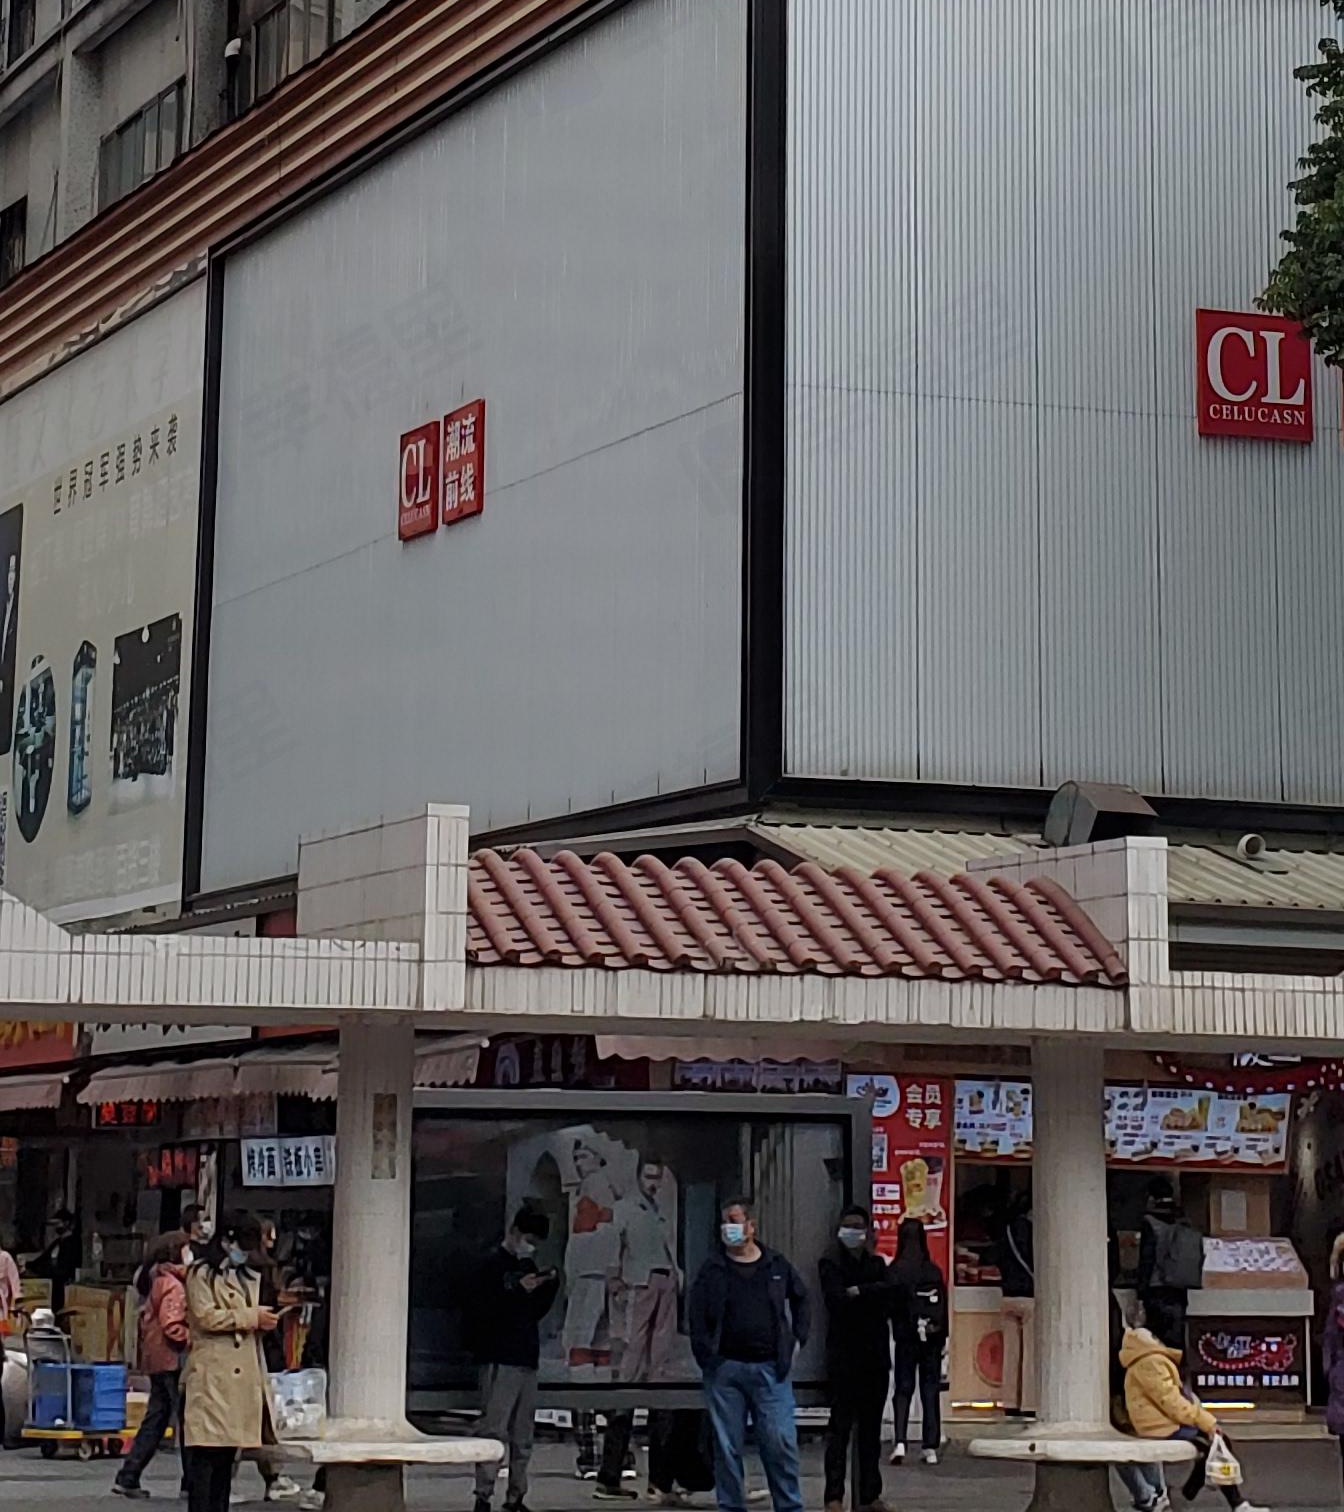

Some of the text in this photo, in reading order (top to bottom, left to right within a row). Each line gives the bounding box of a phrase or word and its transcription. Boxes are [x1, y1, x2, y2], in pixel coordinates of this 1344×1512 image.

[1207, 326, 1305, 406] CL
[446, 413, 477, 462] 潮流
[1209, 403, 1306, 426] CELUCASN
[402, 439, 431, 508] CL
[445, 463, 475, 511] 前线
[905, 1108, 942, 1129] 专享
[906, 1084, 942, 1105] 会员
